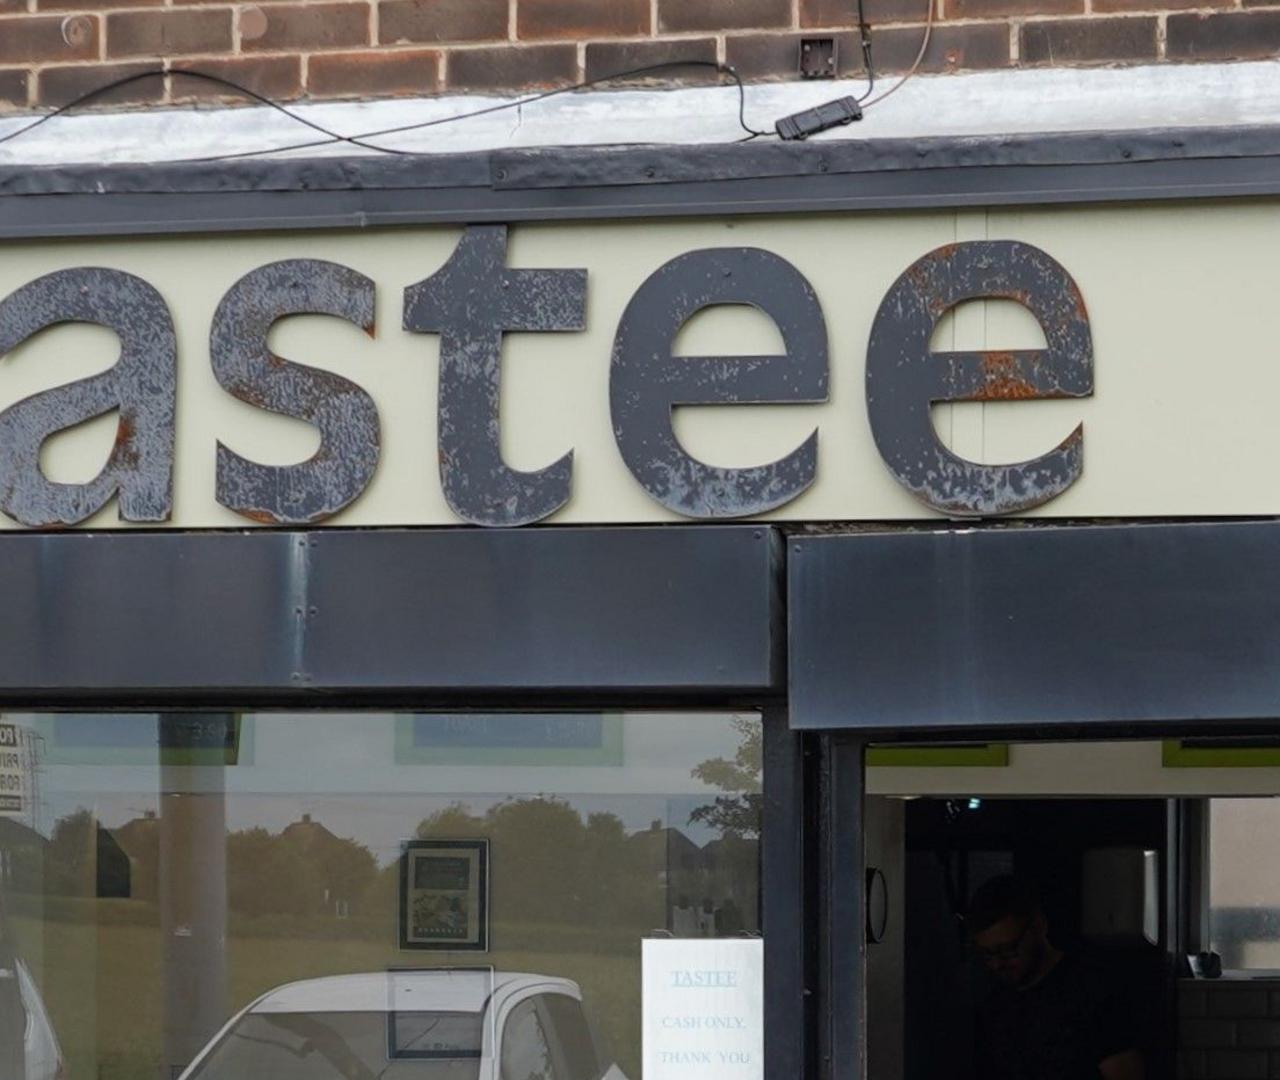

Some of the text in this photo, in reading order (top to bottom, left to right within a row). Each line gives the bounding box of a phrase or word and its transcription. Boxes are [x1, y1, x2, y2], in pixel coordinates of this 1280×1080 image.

[671, 970, 737, 988] TASTEE
[661, 1016, 701, 1029] CASH
[657, 1051, 711, 1064] THANK
